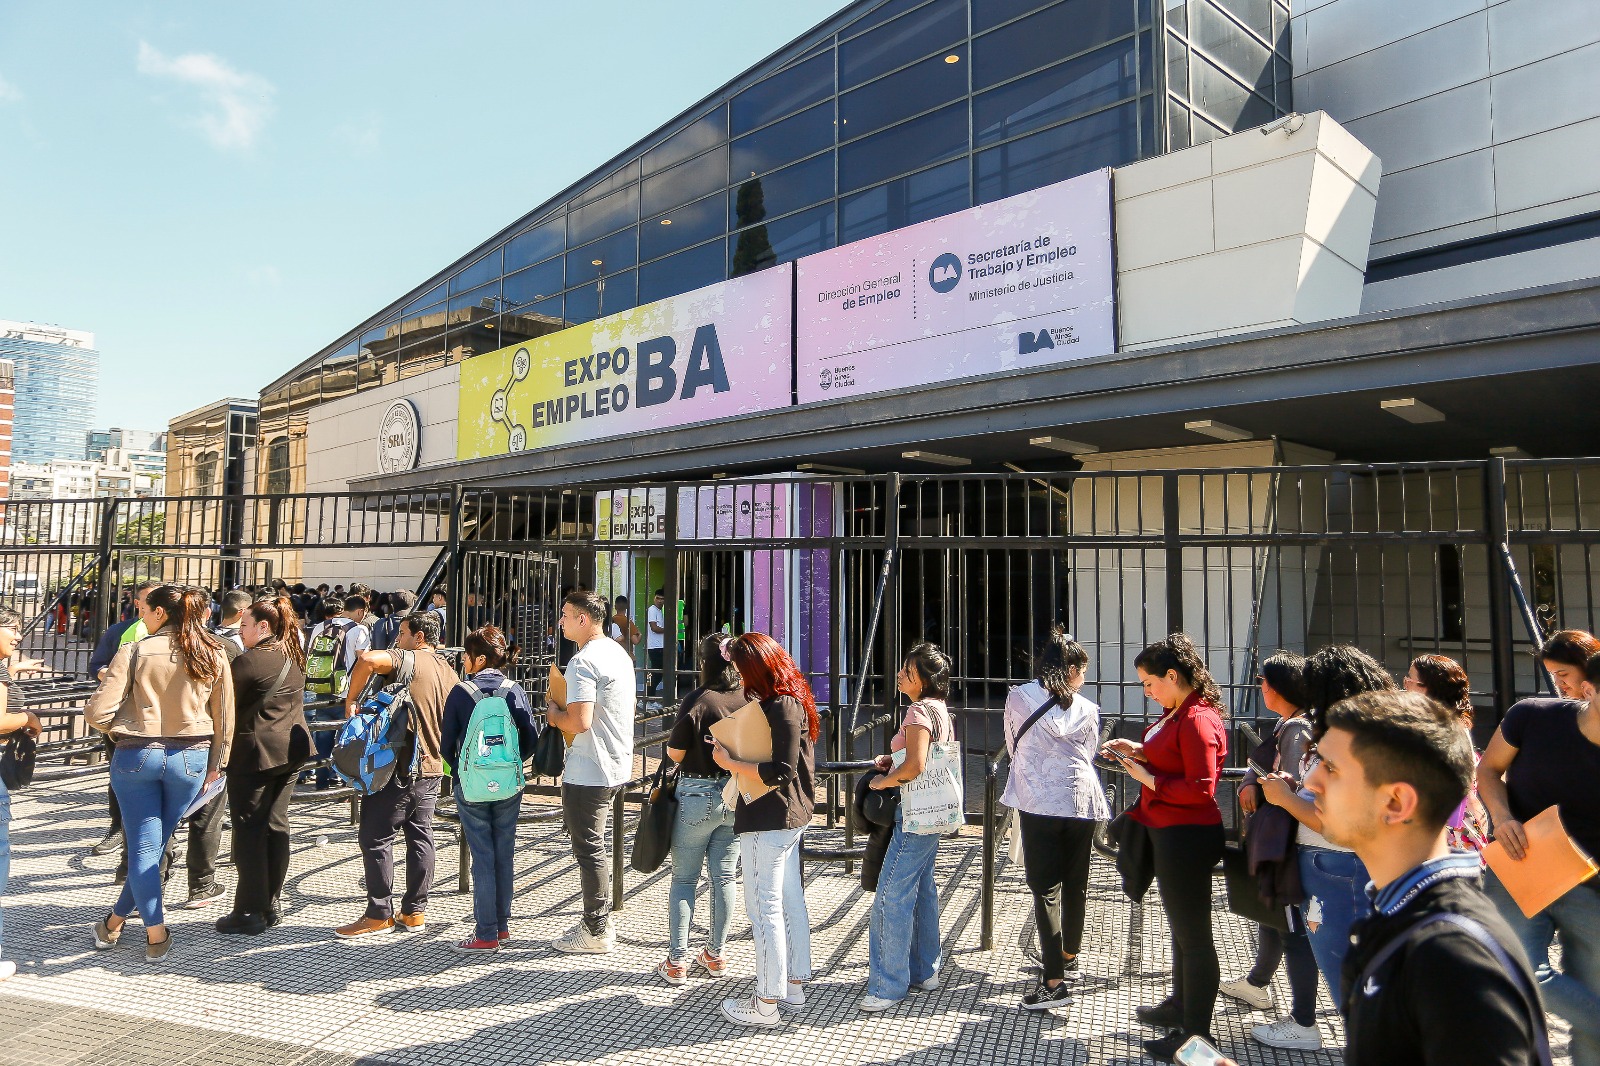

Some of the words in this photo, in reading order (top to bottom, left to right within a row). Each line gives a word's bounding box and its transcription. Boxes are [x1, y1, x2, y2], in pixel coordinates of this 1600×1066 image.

[967, 241, 1031, 265] Secretaría
[1033, 235, 1051, 249] de
[968, 260, 1014, 280] Trabajo
[1016, 258, 1024, 271] y
[1026, 244, 1078, 265] Empleo
[818, 283, 861, 302] Dirección
[863, 272, 901, 291] General
[842, 298, 857, 310] de
[858, 287, 901, 307] Empleo
[968, 284, 1016, 301] Ministerio
[1018, 280, 1031, 291] de
[1033, 270, 1074, 288] Justicia
[564, 346, 630, 387] EXPO
[636, 323, 731, 408] BA
[532, 383, 630, 428] EMPLEO
[387, 433, 405, 448] SRA
[614, 521, 656, 536] EMPLEO
